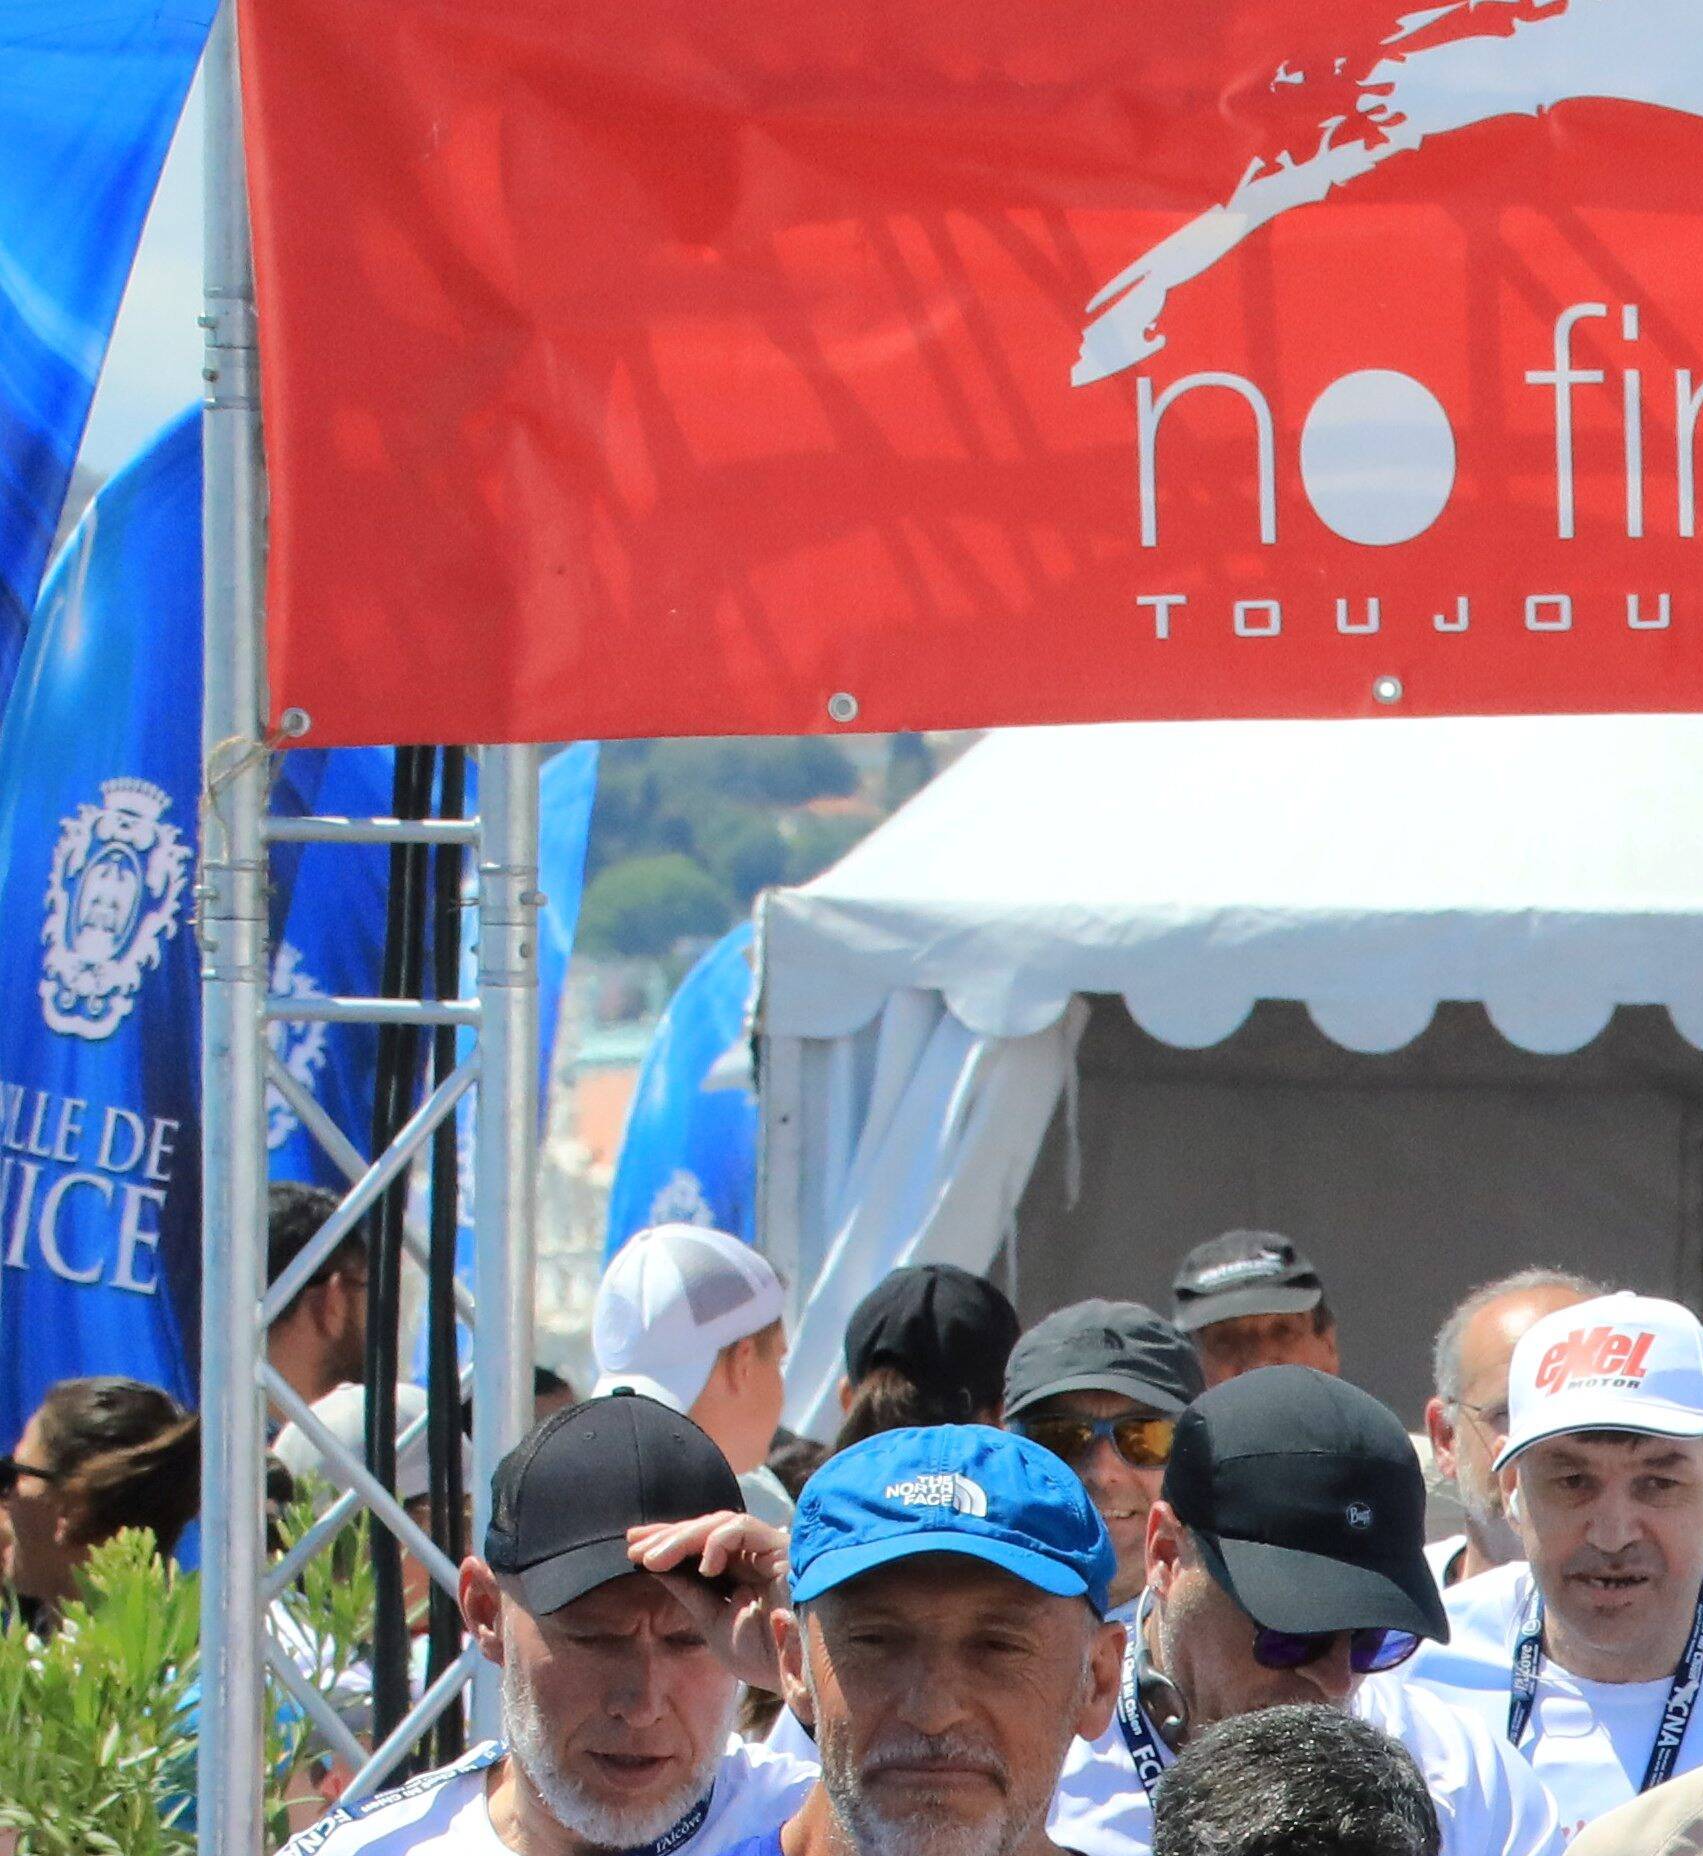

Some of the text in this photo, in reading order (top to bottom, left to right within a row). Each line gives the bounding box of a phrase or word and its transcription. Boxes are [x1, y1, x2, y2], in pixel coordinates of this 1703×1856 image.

[1137, 368, 1456, 547] no
[96, 1105, 181, 1182] DE
[1567, 1375, 1642, 1391] MOTOR
[917, 1475, 952, 1487] THE
[885, 1482, 954, 1500] NORTH
[903, 1493, 954, 1507] FACE
